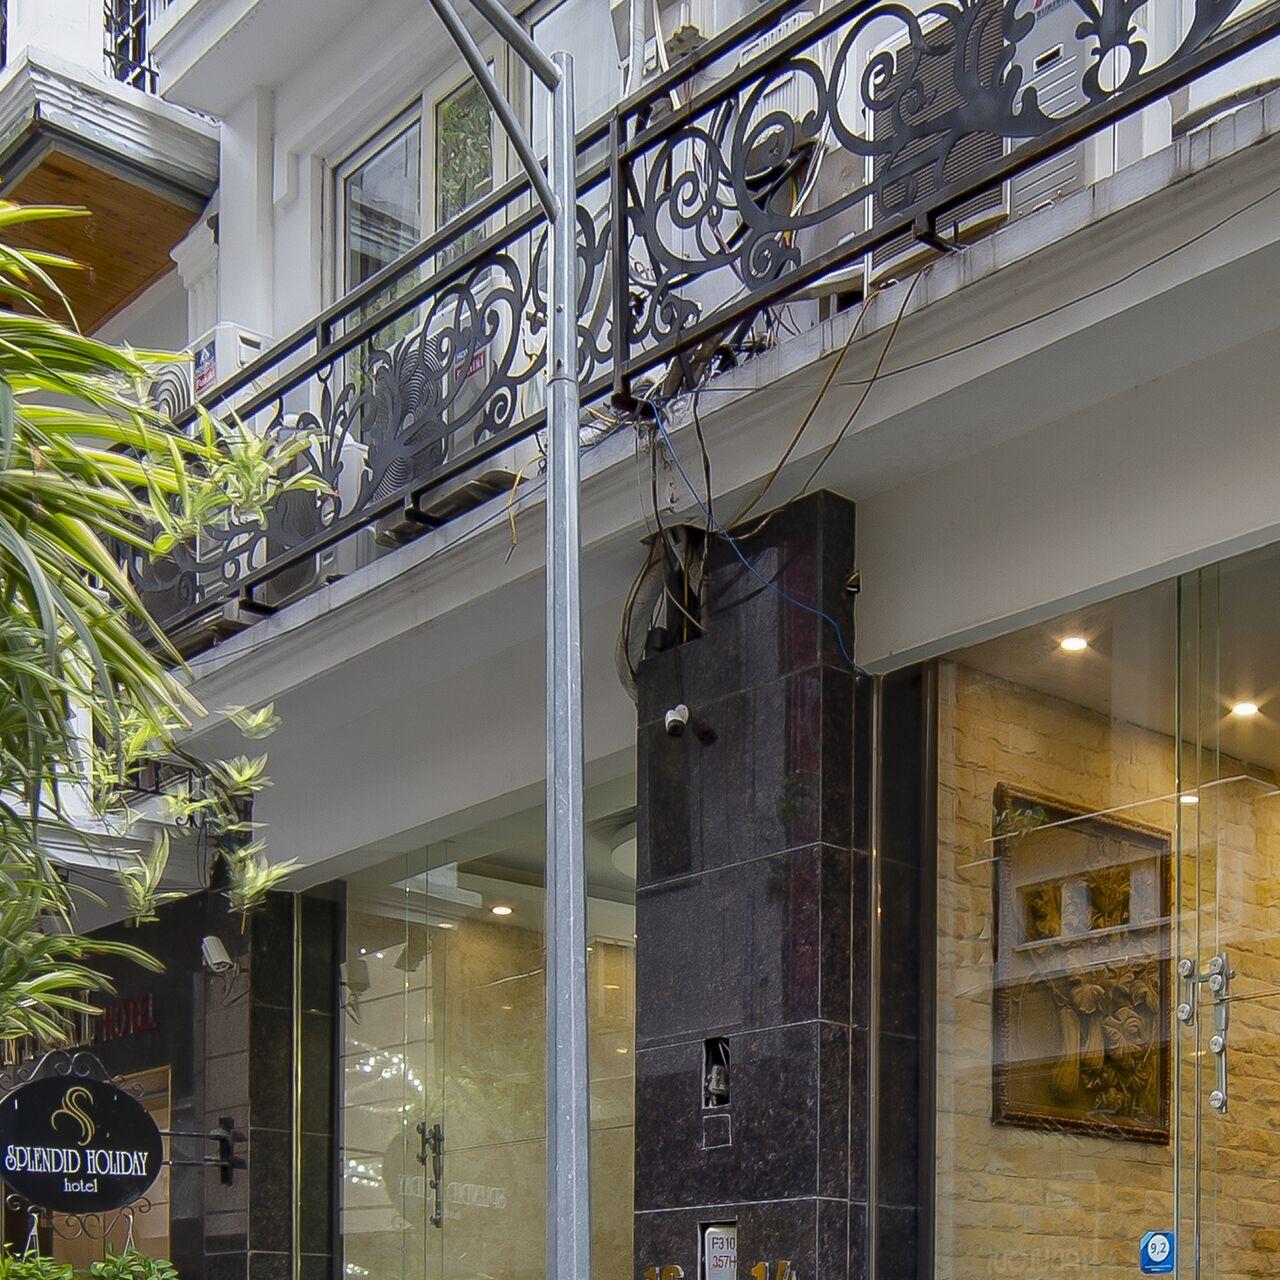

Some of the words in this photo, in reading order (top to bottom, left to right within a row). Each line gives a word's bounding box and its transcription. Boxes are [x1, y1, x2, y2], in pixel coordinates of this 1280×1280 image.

[5, 1145, 80, 1174] SPLENDID
[87, 1149, 149, 1175] HOLIDAY
[64, 1178, 98, 1193] hotel
[1150, 1242, 1167, 1255] 9,2
